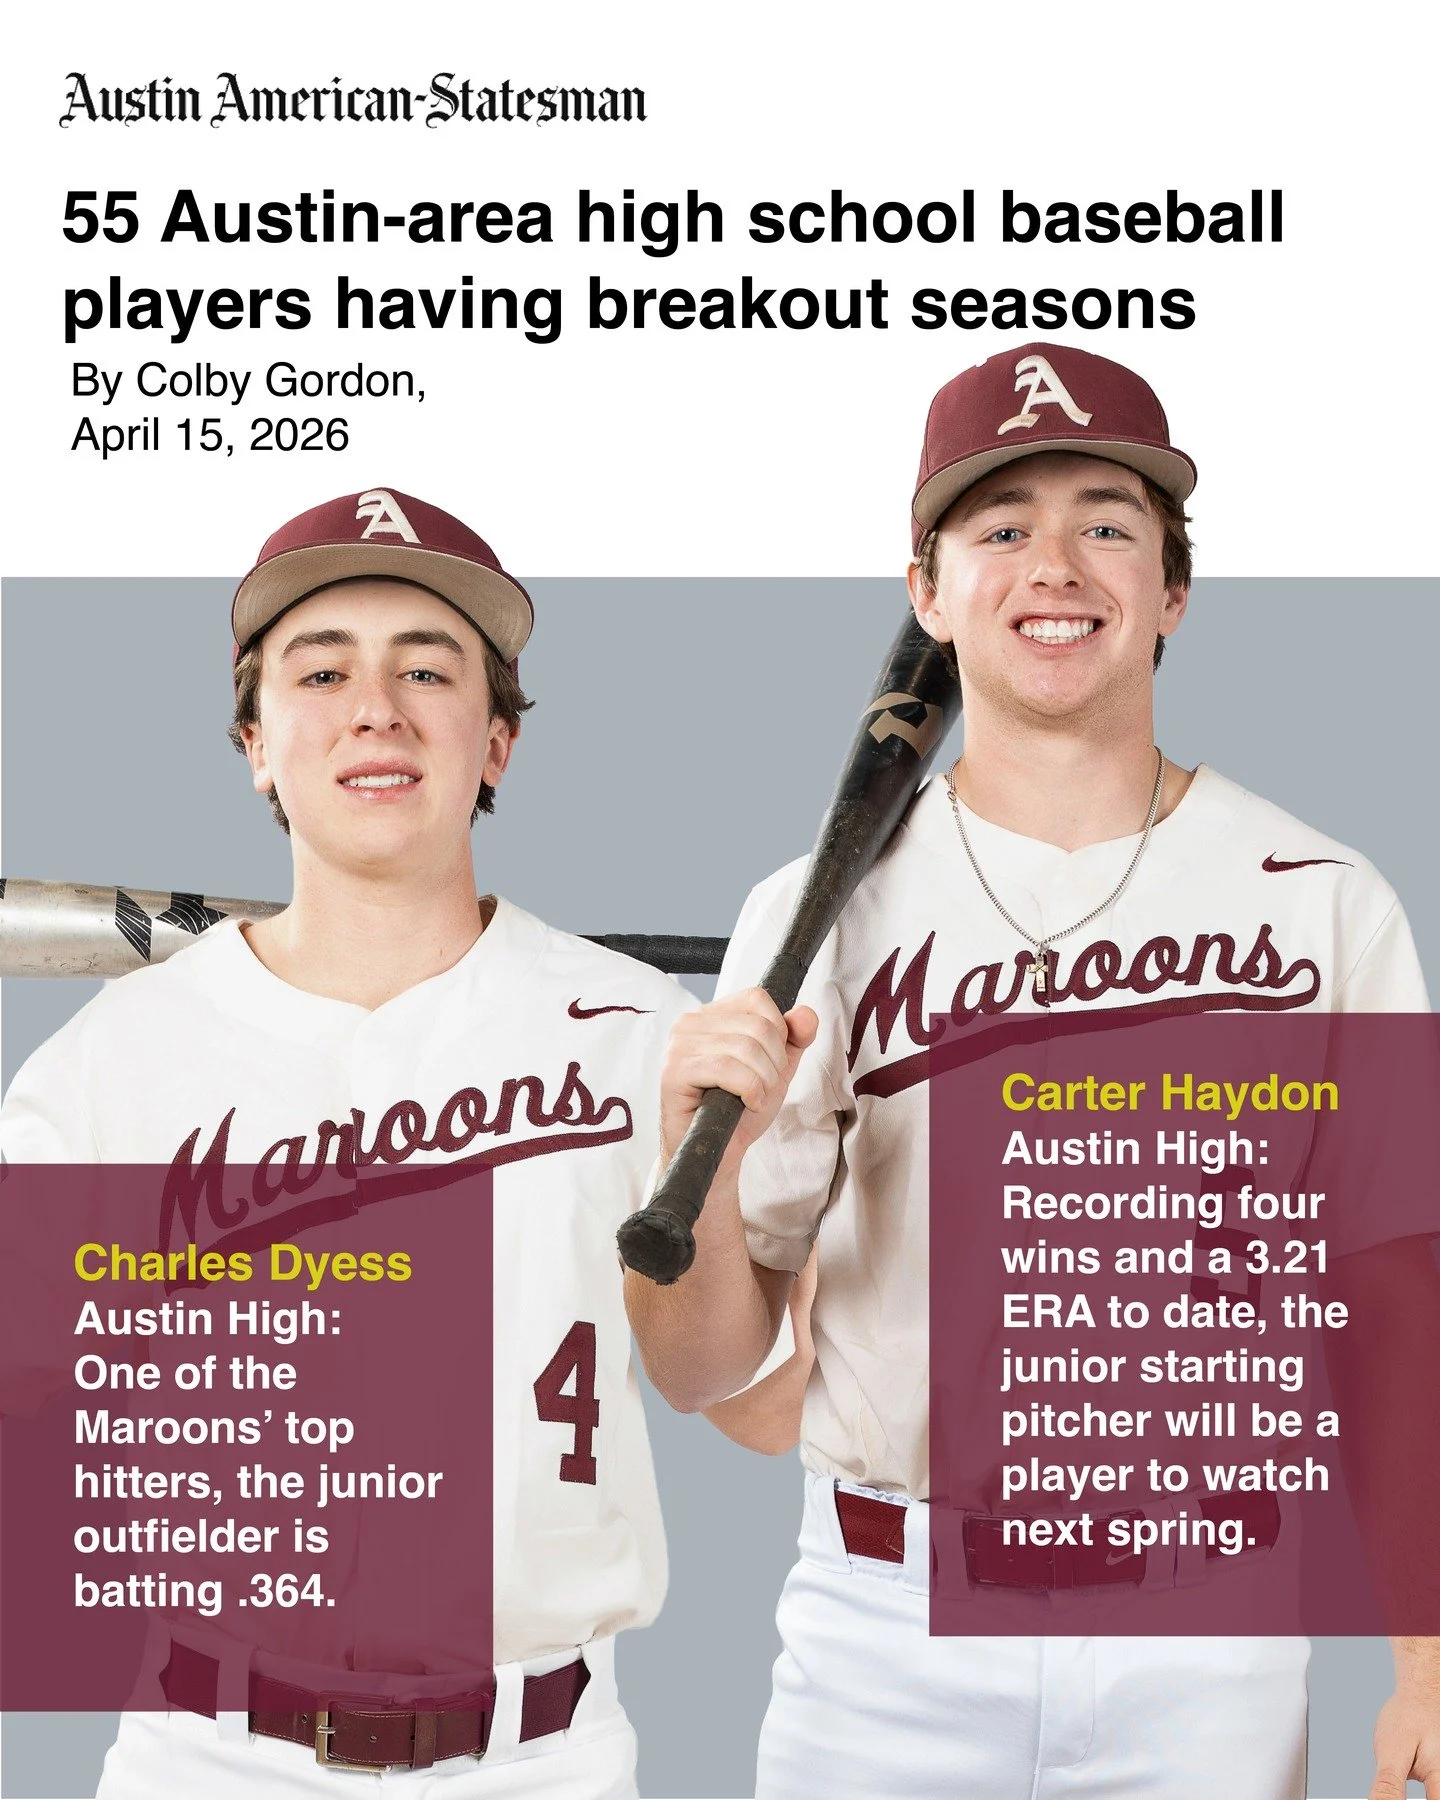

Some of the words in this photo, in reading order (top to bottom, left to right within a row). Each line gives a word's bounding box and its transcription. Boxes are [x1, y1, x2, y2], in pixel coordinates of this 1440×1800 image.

[997, 354, 1093, 436] A
[355, 489, 422, 544] A
[847, 923, 1321, 1074] Maroons
[158, 1061, 633, 1257] Maroons
[533, 1321, 601, 1485] 4
